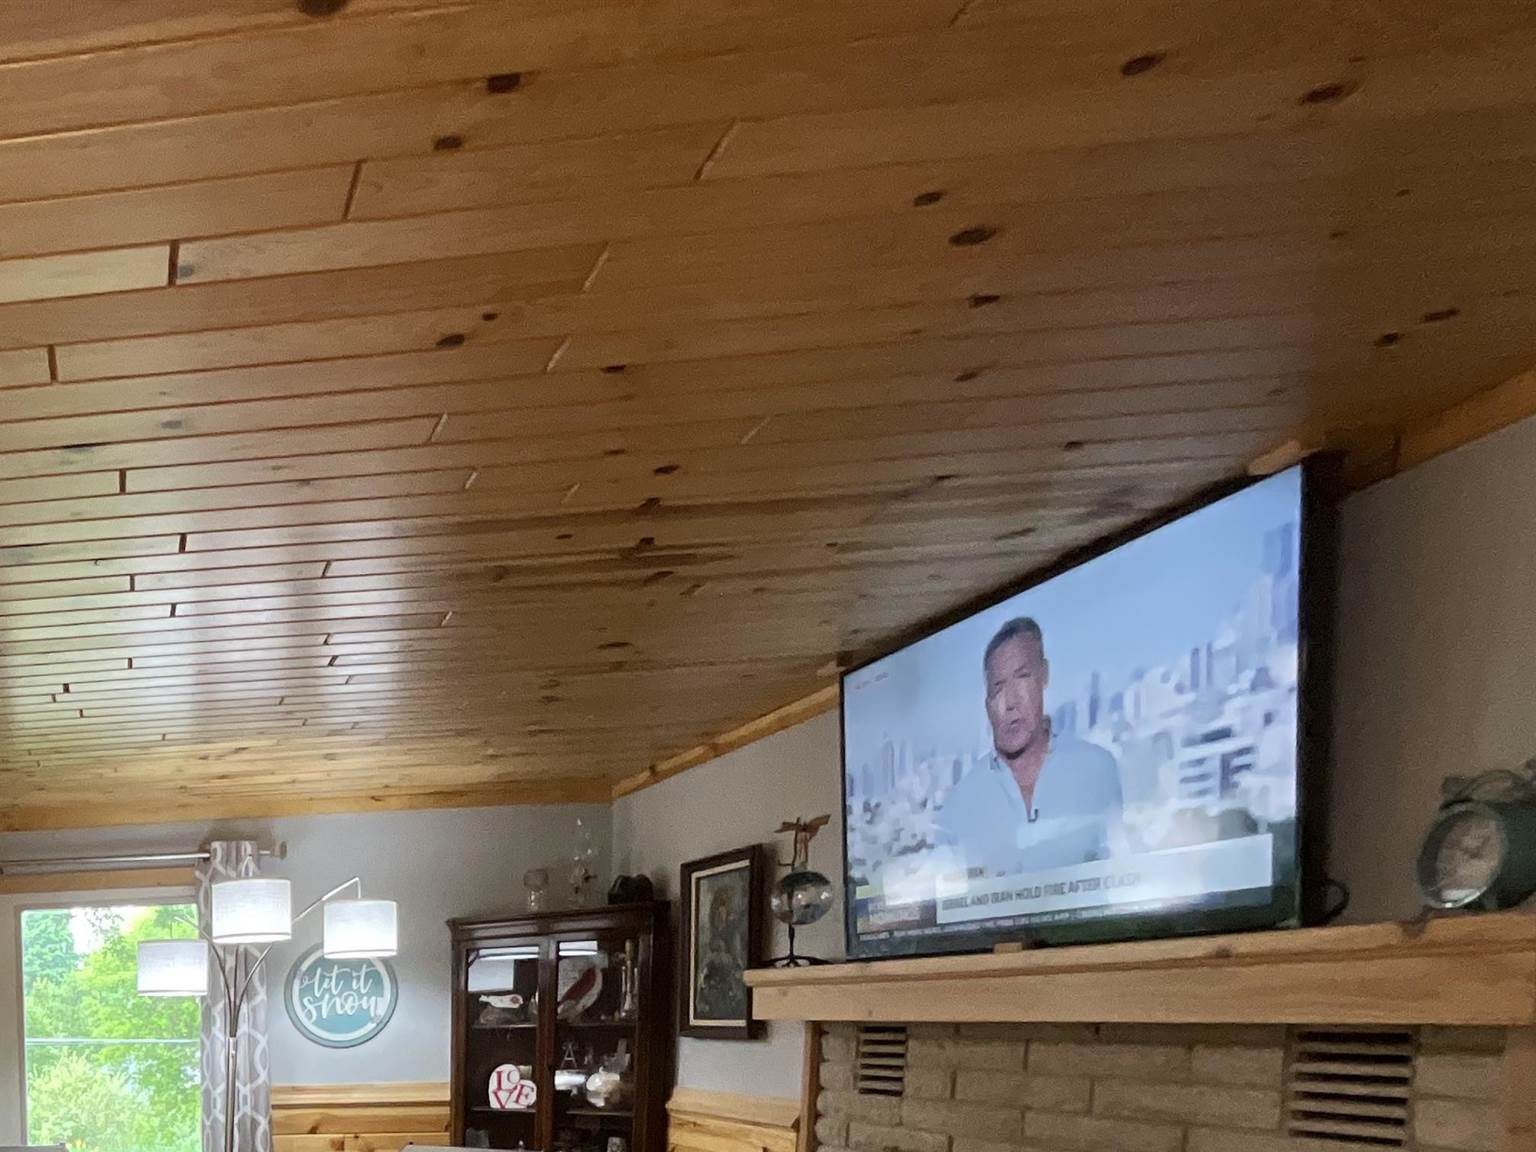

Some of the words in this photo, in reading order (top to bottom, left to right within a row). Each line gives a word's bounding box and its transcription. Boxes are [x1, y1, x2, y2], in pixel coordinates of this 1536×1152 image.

[969, 893, 989, 906] AND
[1015, 886, 1041, 900] HOLD
[1068, 877, 1100, 893] AFTER
